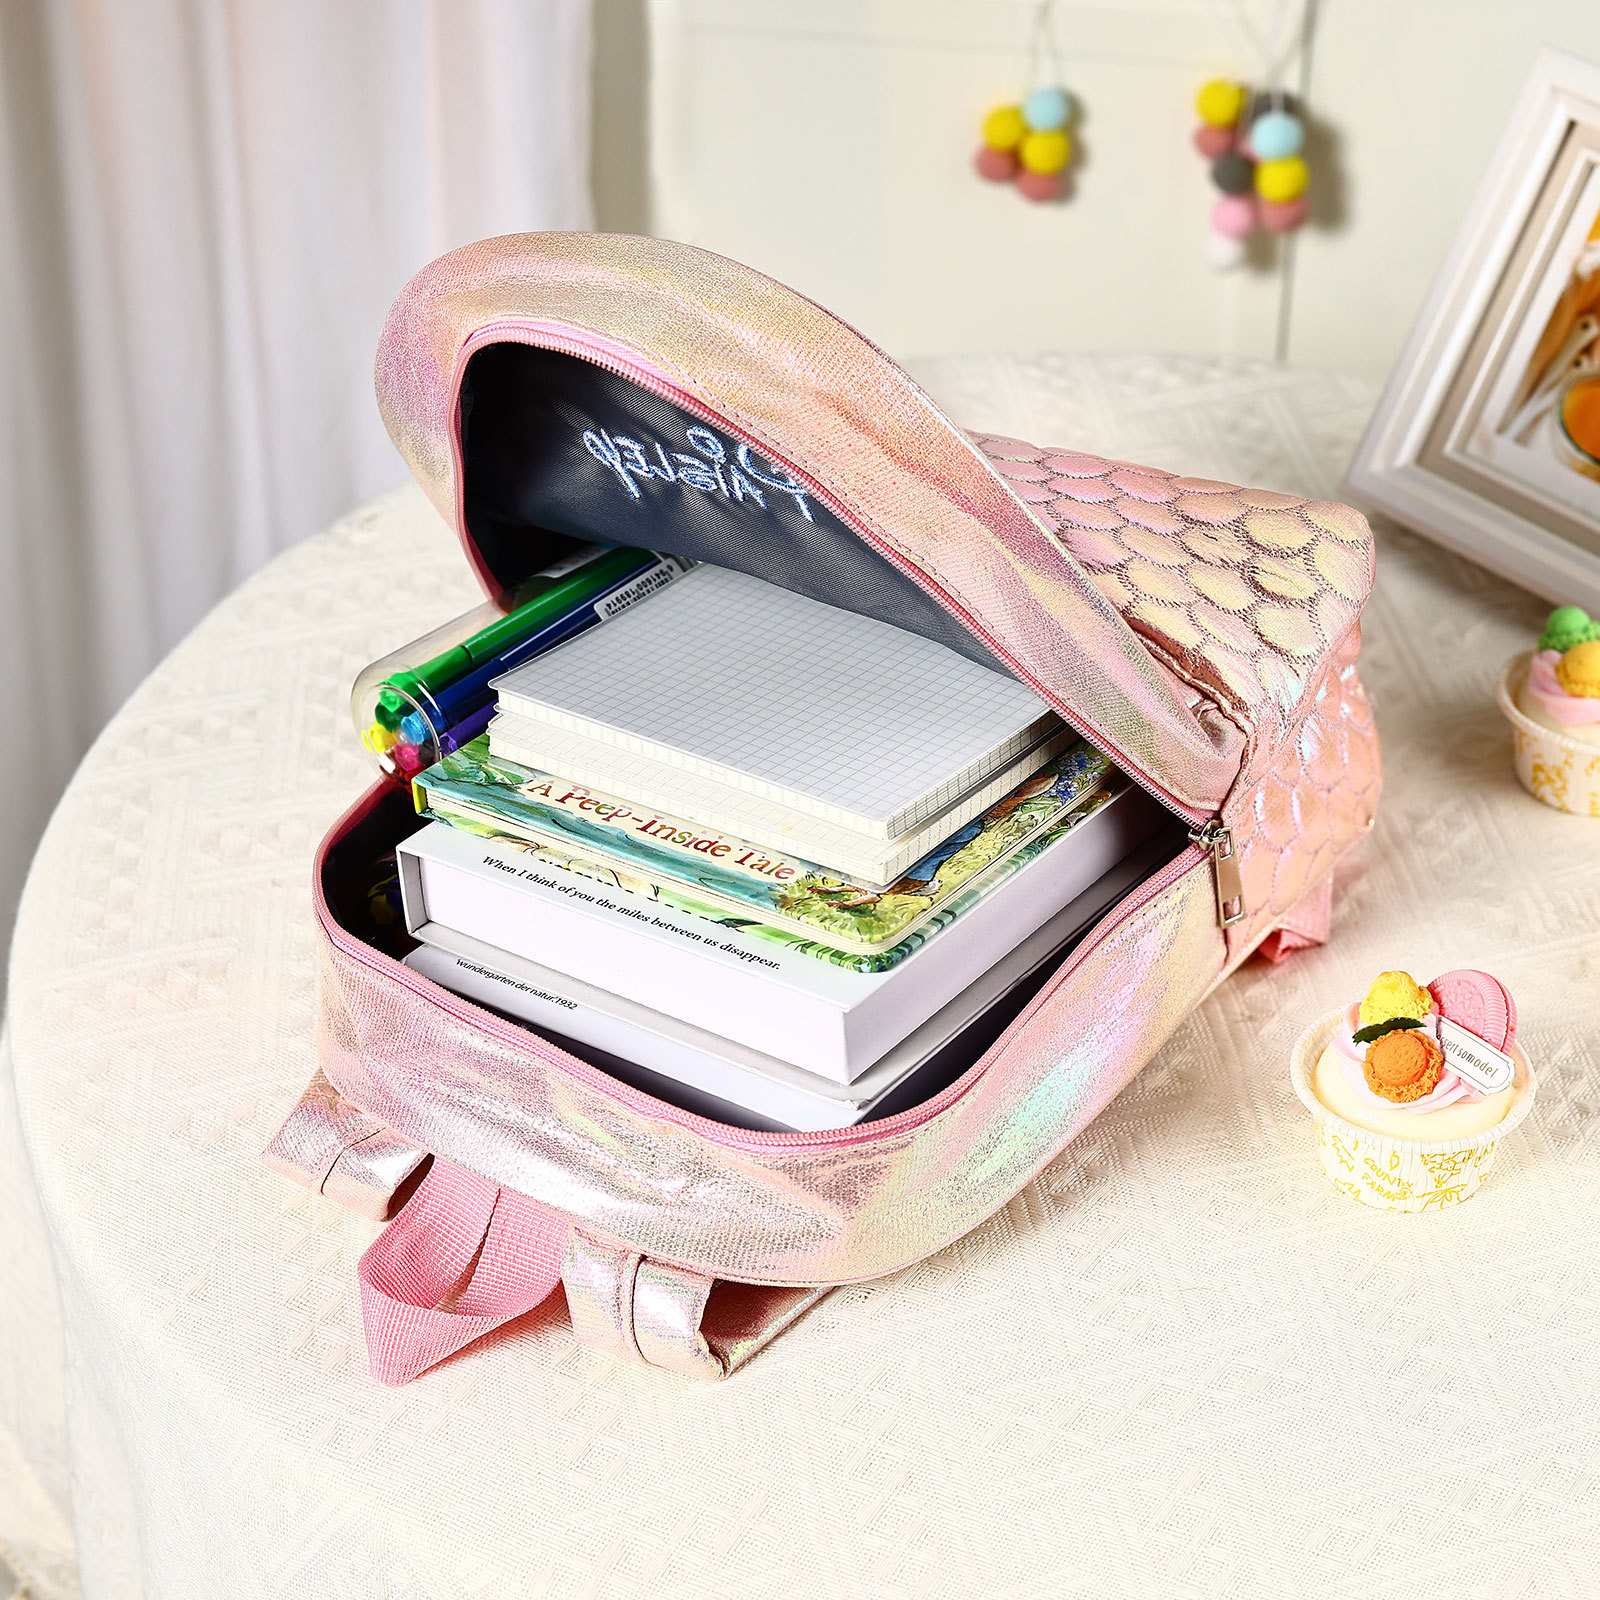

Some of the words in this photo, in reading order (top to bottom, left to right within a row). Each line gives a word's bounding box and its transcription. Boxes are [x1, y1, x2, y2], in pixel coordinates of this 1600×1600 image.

[605, 588, 636, 611] 189914
[527, 780, 553, 797] A
[734, 845, 795, 880] Tale
[483, 856, 518, 875] When
[517, 869, 527, 879] I
[526, 872, 557, 890] think
[558, 884, 577, 900] of
[571, 890, 595, 905] you
[596, 898, 616, 911] the
[617, 904, 650, 923] miles
[651, 917, 702, 942] between
[703, 937, 719, 948] us
[720, 942, 781, 970] disappear.
[515, 982, 531, 993] der
